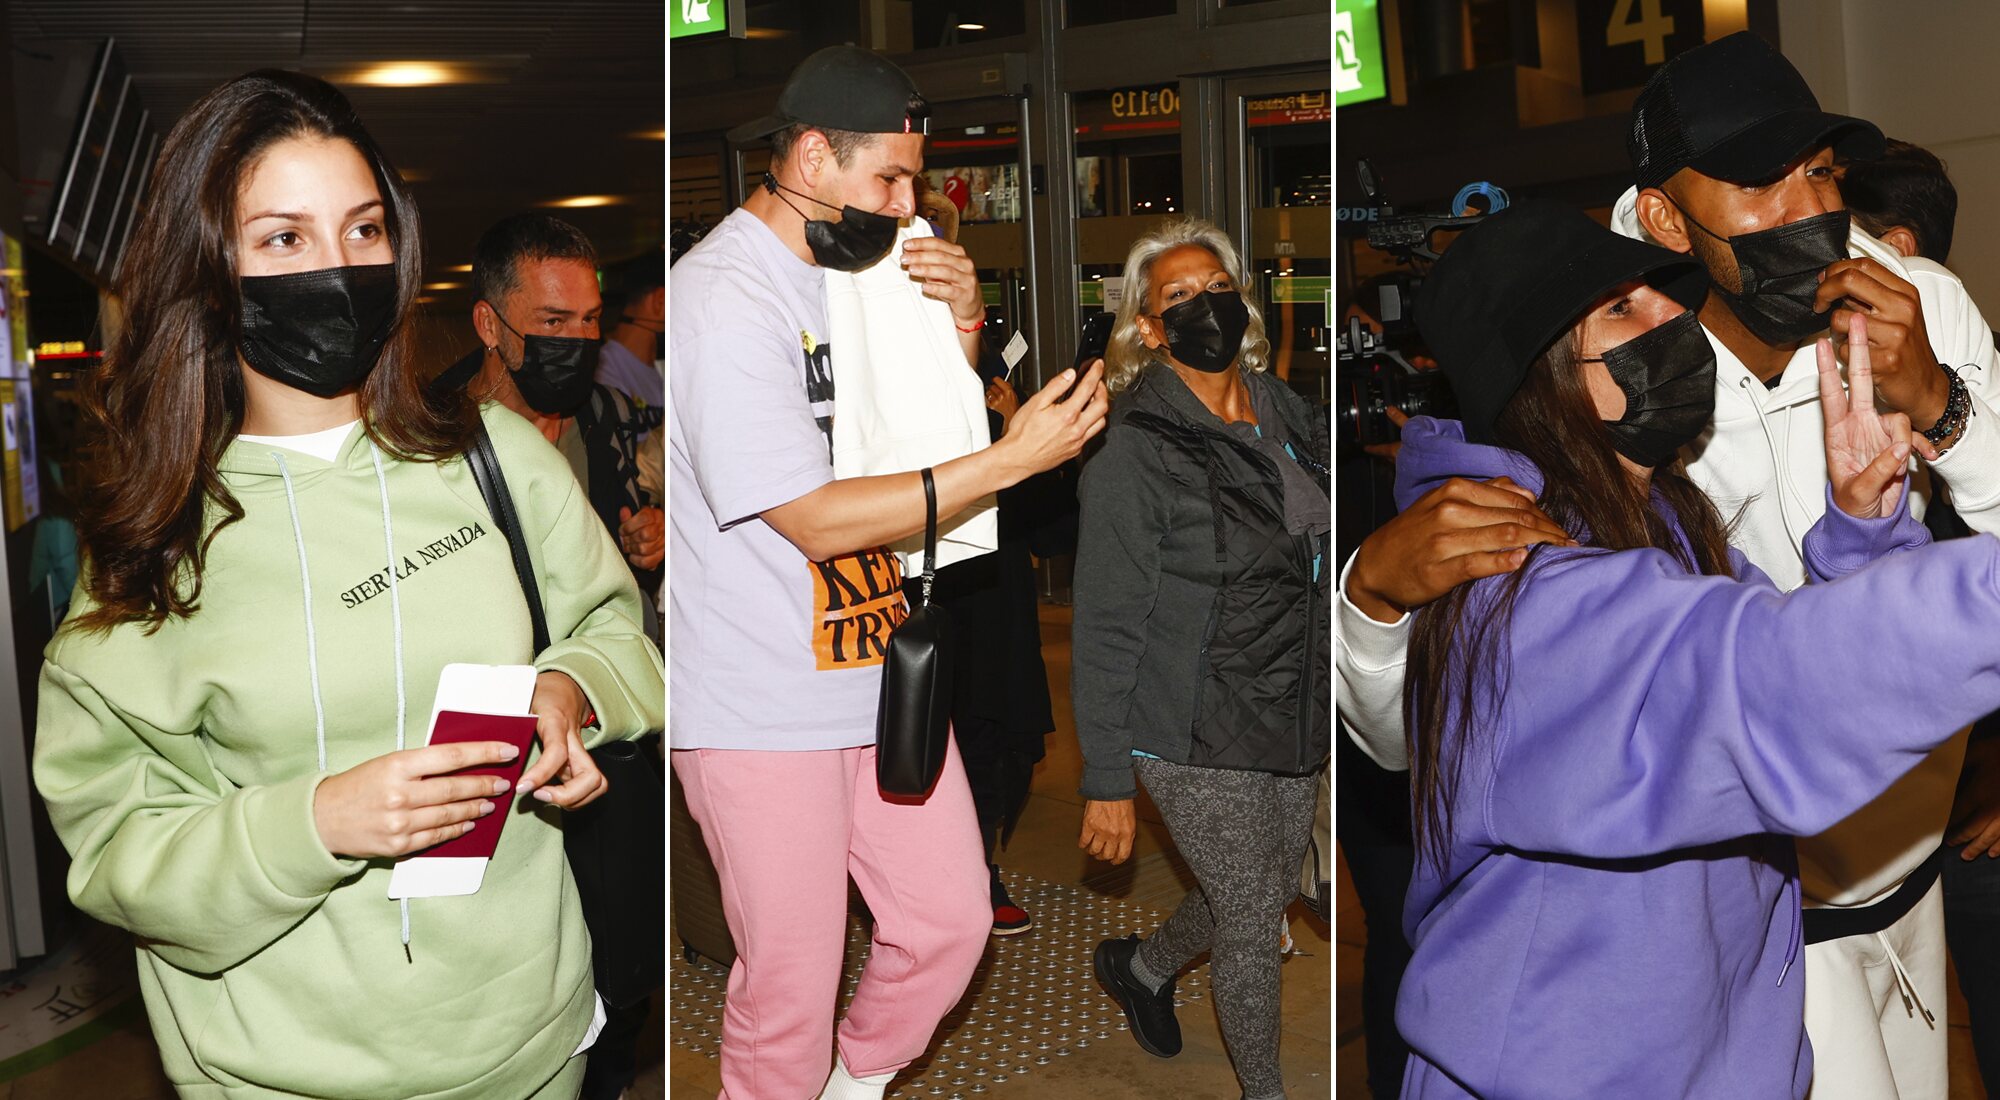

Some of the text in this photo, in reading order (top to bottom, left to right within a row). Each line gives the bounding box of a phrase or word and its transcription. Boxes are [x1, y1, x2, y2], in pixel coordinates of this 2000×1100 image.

[1606, 0, 1674, 65] 4
[340, 521, 486, 609] SIERRA NEVADA
